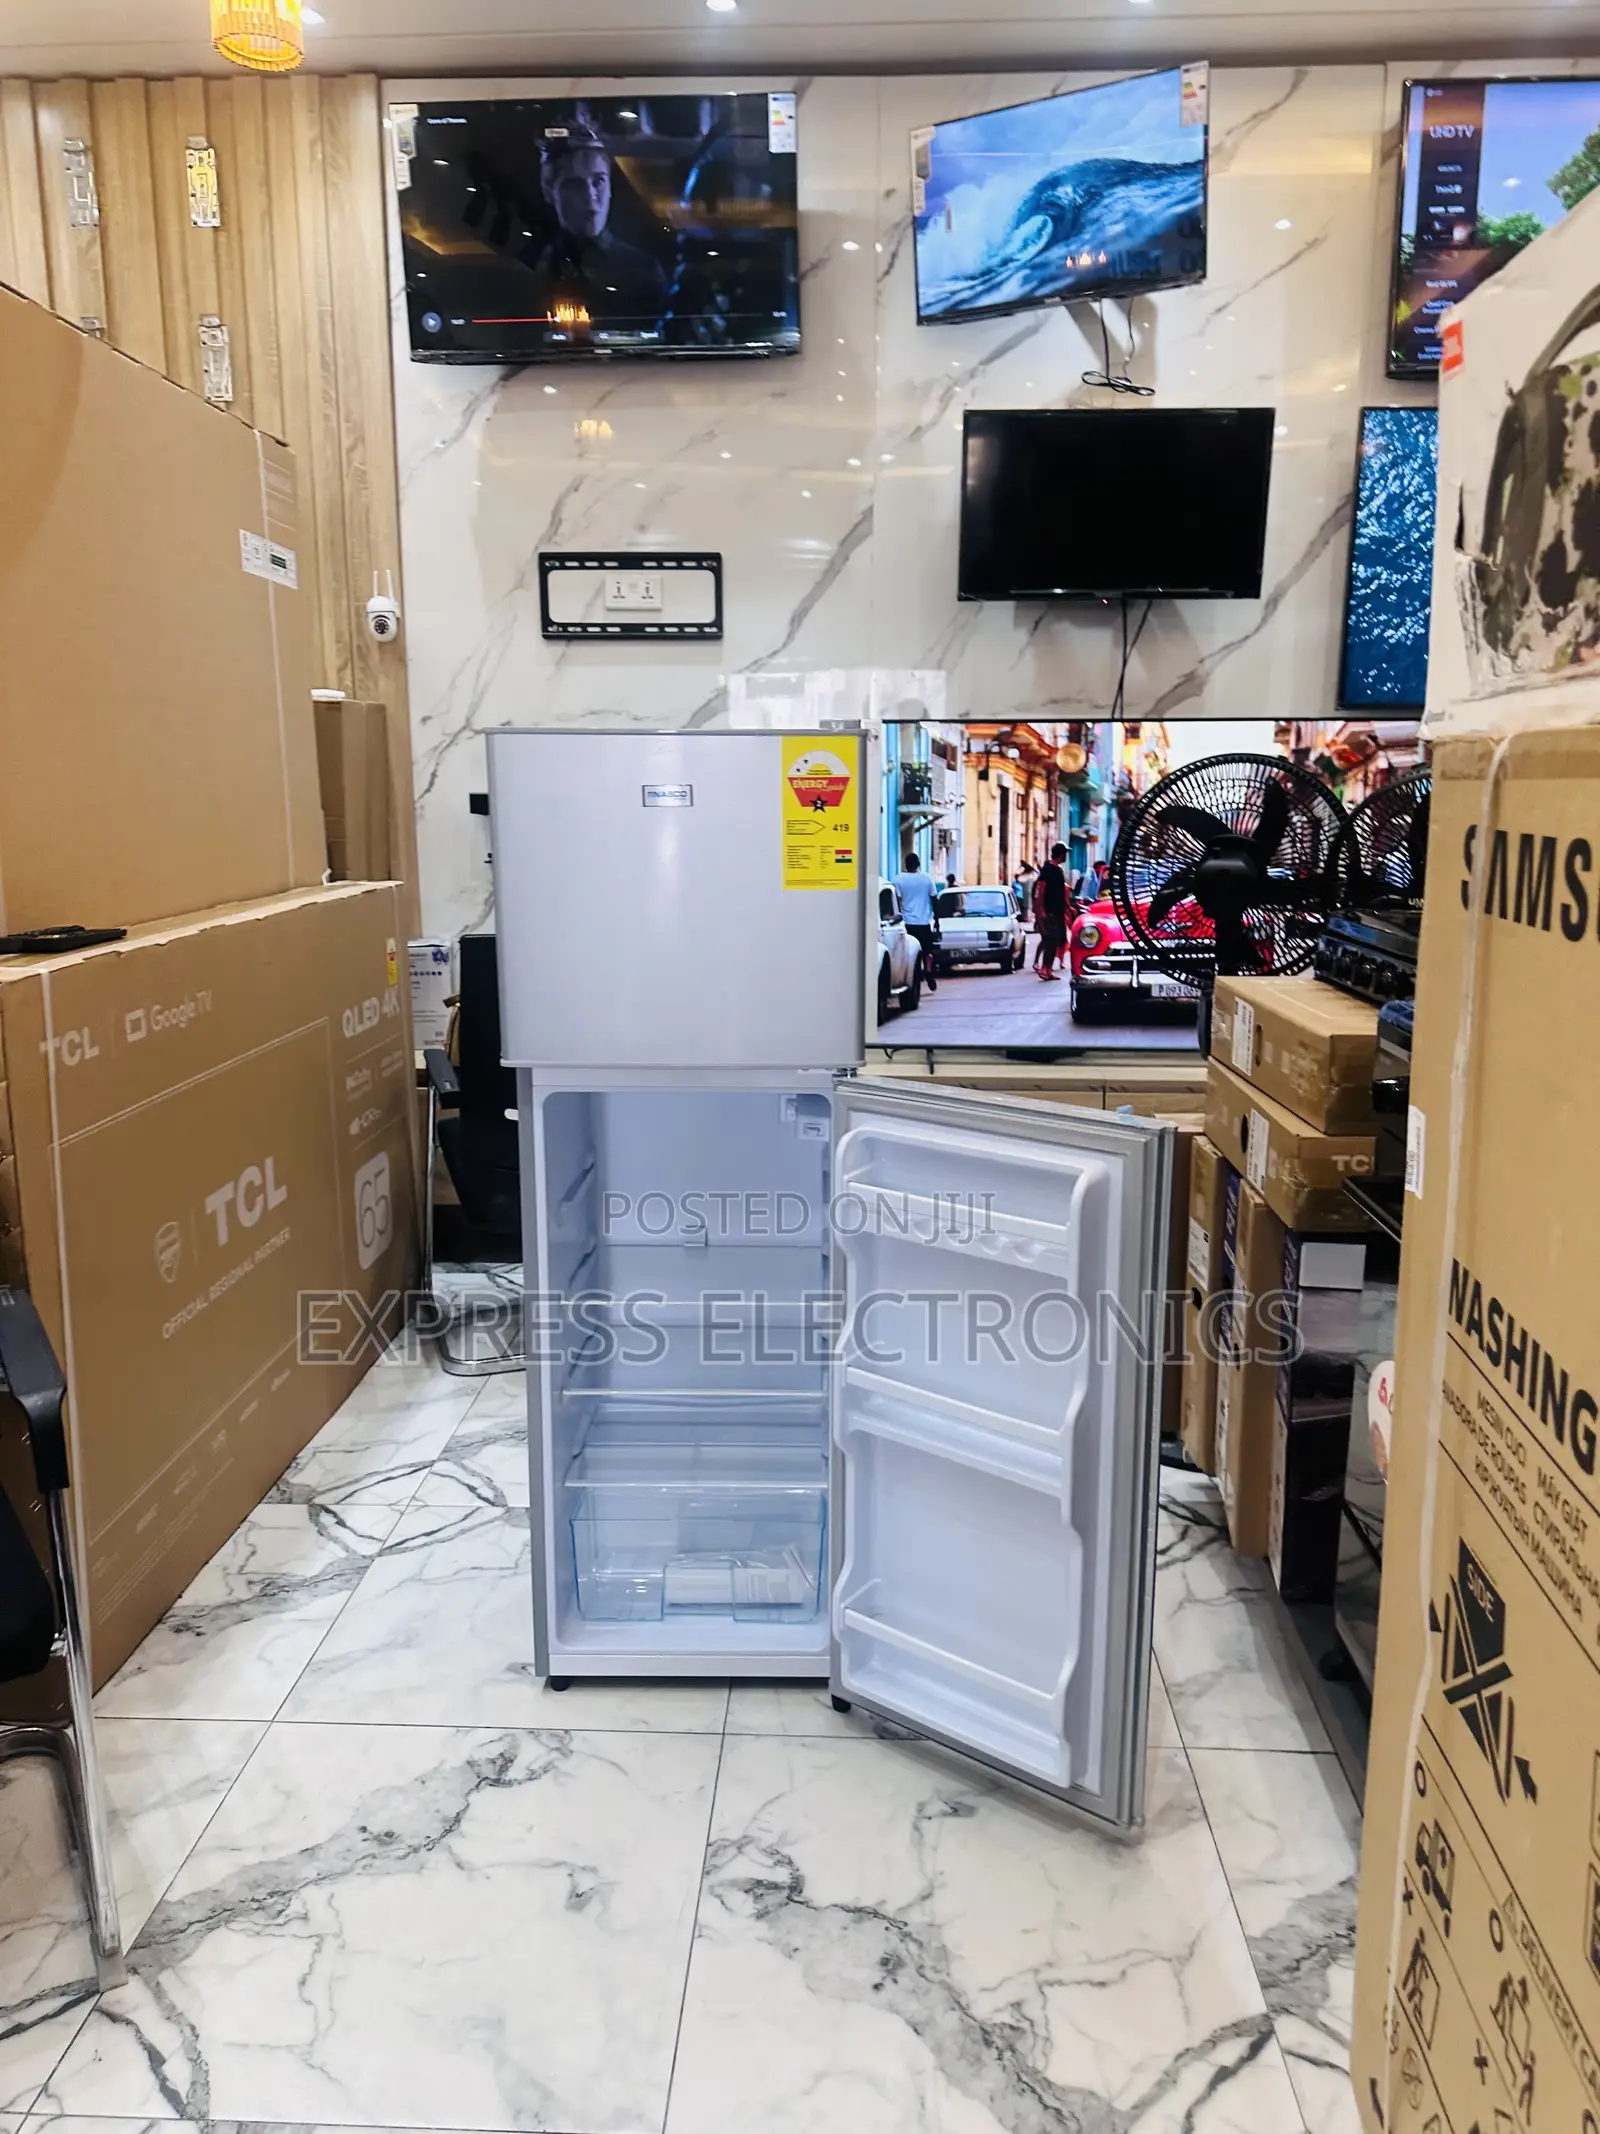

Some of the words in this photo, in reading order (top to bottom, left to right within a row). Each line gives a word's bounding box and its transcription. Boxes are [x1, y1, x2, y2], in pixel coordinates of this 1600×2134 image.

[1457, 124, 1476, 138] TV
[832, 823, 850, 832] 419
[1461, 824, 1600, 944] SAMS
[151, 996, 196, 1032] Google
[342, 996, 380, 1038] QLED
[39, 1026, 100, 1066] TCL
[1331, 1154, 1375, 1173] TC
[205, 1155, 288, 1247] TCL
[359, 1167, 389, 1249] 65
[162, 1293, 209, 1339] OFFICIAL
[208, 1256, 254, 1302] REGIONAL
[1491, 1442, 1527, 1506] ROUPAS
[1466, 1562, 1495, 1624] SIDE
